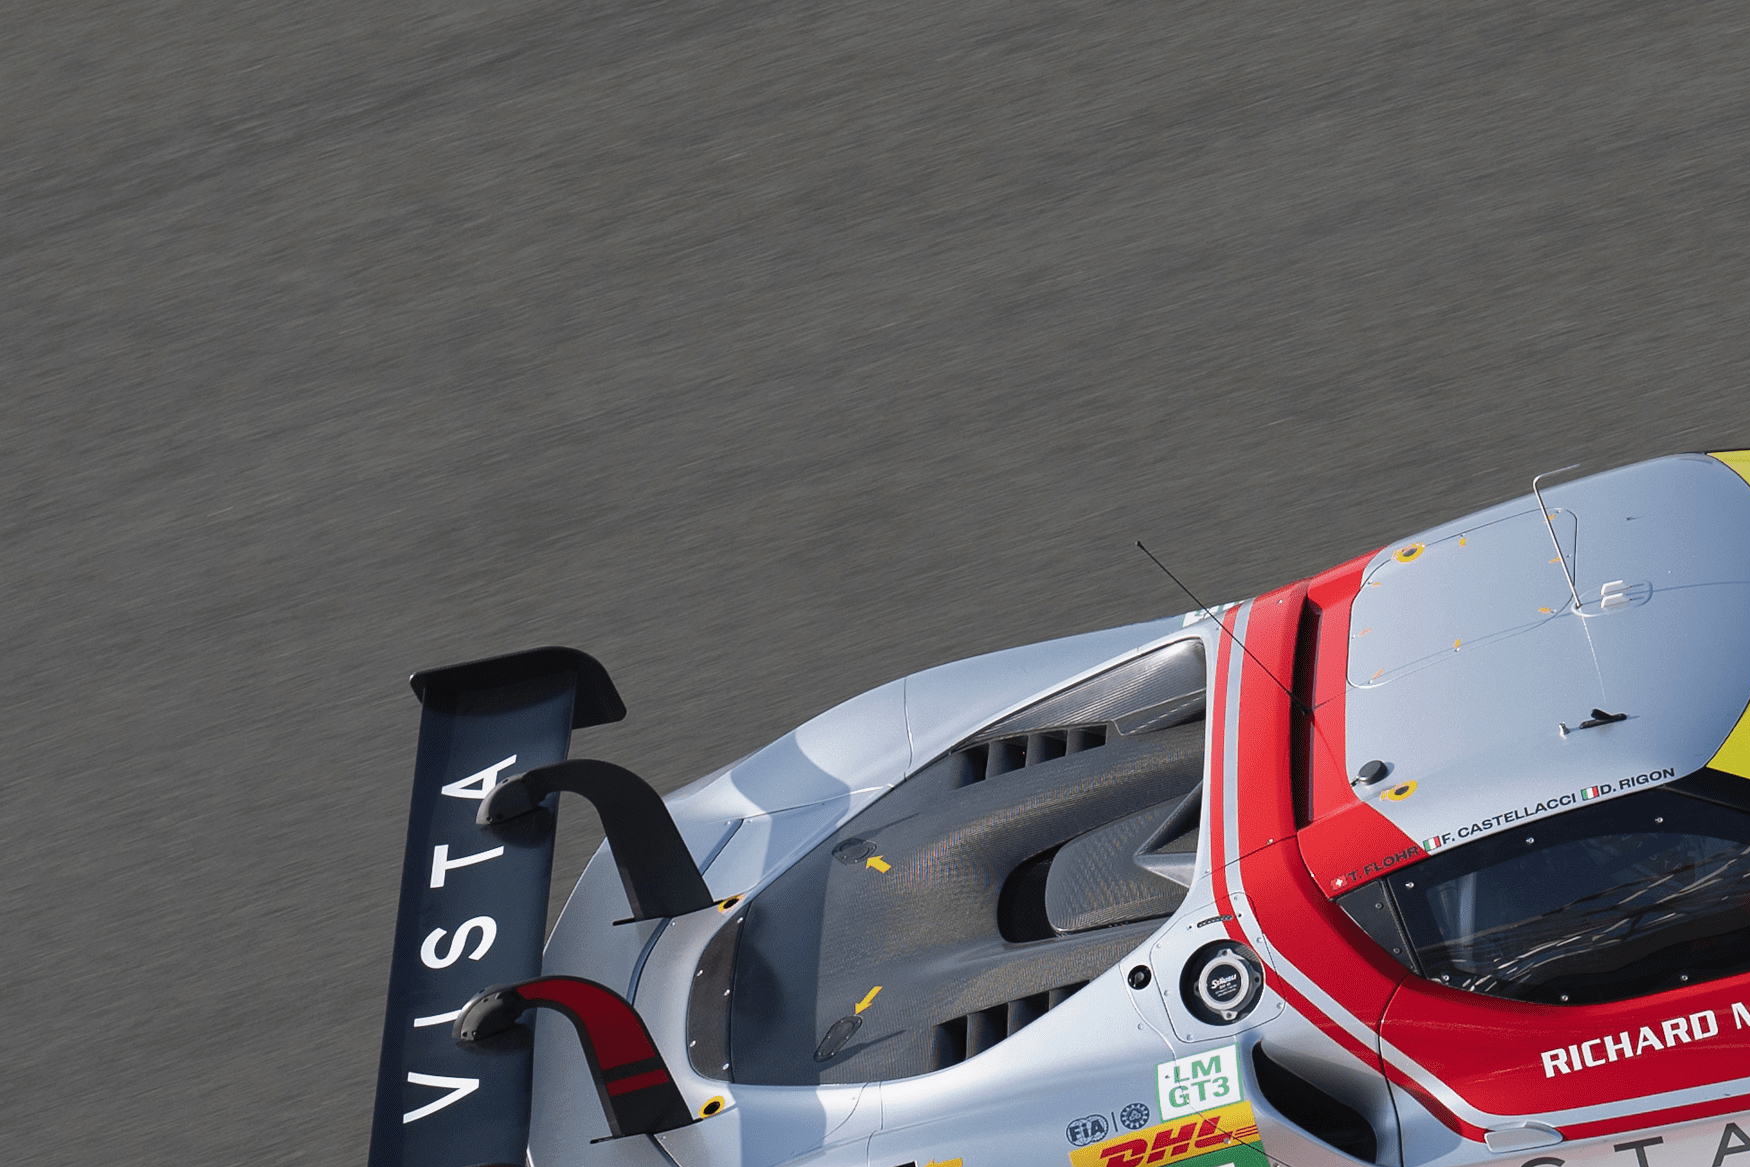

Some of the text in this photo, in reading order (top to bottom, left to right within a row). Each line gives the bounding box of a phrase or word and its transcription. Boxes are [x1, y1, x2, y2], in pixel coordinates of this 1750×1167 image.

[1599, 767, 1676, 796] D. RIGON
[1440, 792, 1578, 846] F. CASTELLACCI
[1347, 845, 1420, 882] T. FLOHR
[403, 754, 518, 1124] VISTA
[1540, 1009, 1719, 1079] RICHARD
[1173, 1055, 1222, 1084] LM
[1168, 1076, 1231, 1108] GT3
